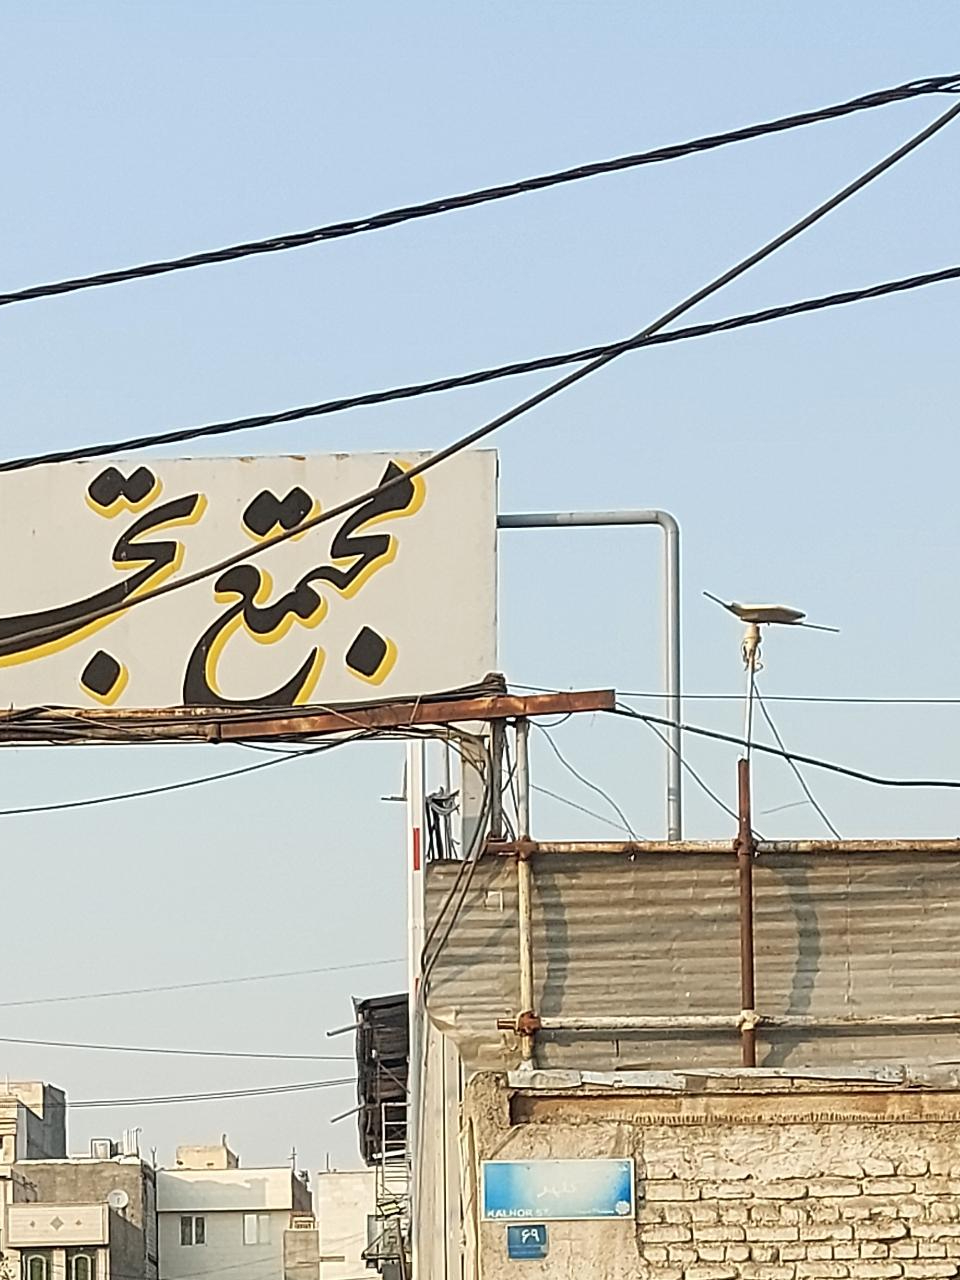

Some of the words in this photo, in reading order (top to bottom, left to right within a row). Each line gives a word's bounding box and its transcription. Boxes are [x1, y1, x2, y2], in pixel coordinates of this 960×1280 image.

[183, 461, 424, 706] مجتمع
[487, 1207, 533, 1218] KALHOR
[521, 1228, 540, 1244] ۶۹
